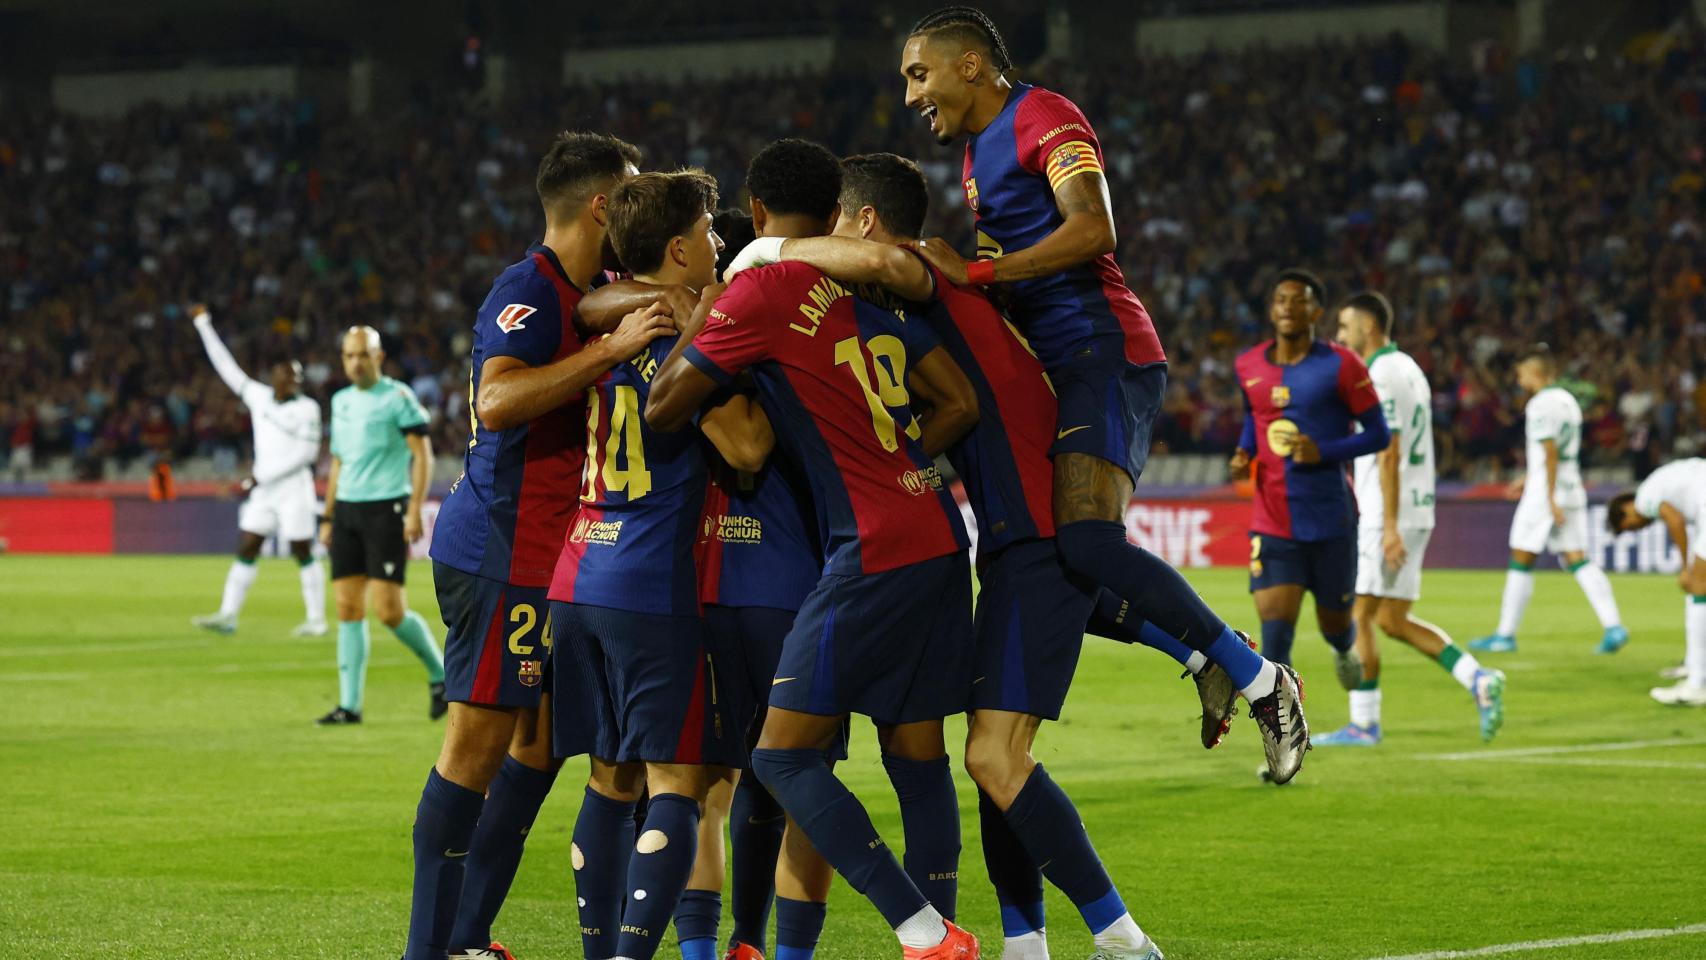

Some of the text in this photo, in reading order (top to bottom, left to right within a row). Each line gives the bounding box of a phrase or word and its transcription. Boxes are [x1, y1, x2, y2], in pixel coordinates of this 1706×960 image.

[579, 385, 652, 502] 14
[590, 520, 623, 531] UNHCR
[718, 514, 761, 529] UNHCR
[584, 529, 619, 541] ACNUR
[716, 526, 762, 539] ACNUR
